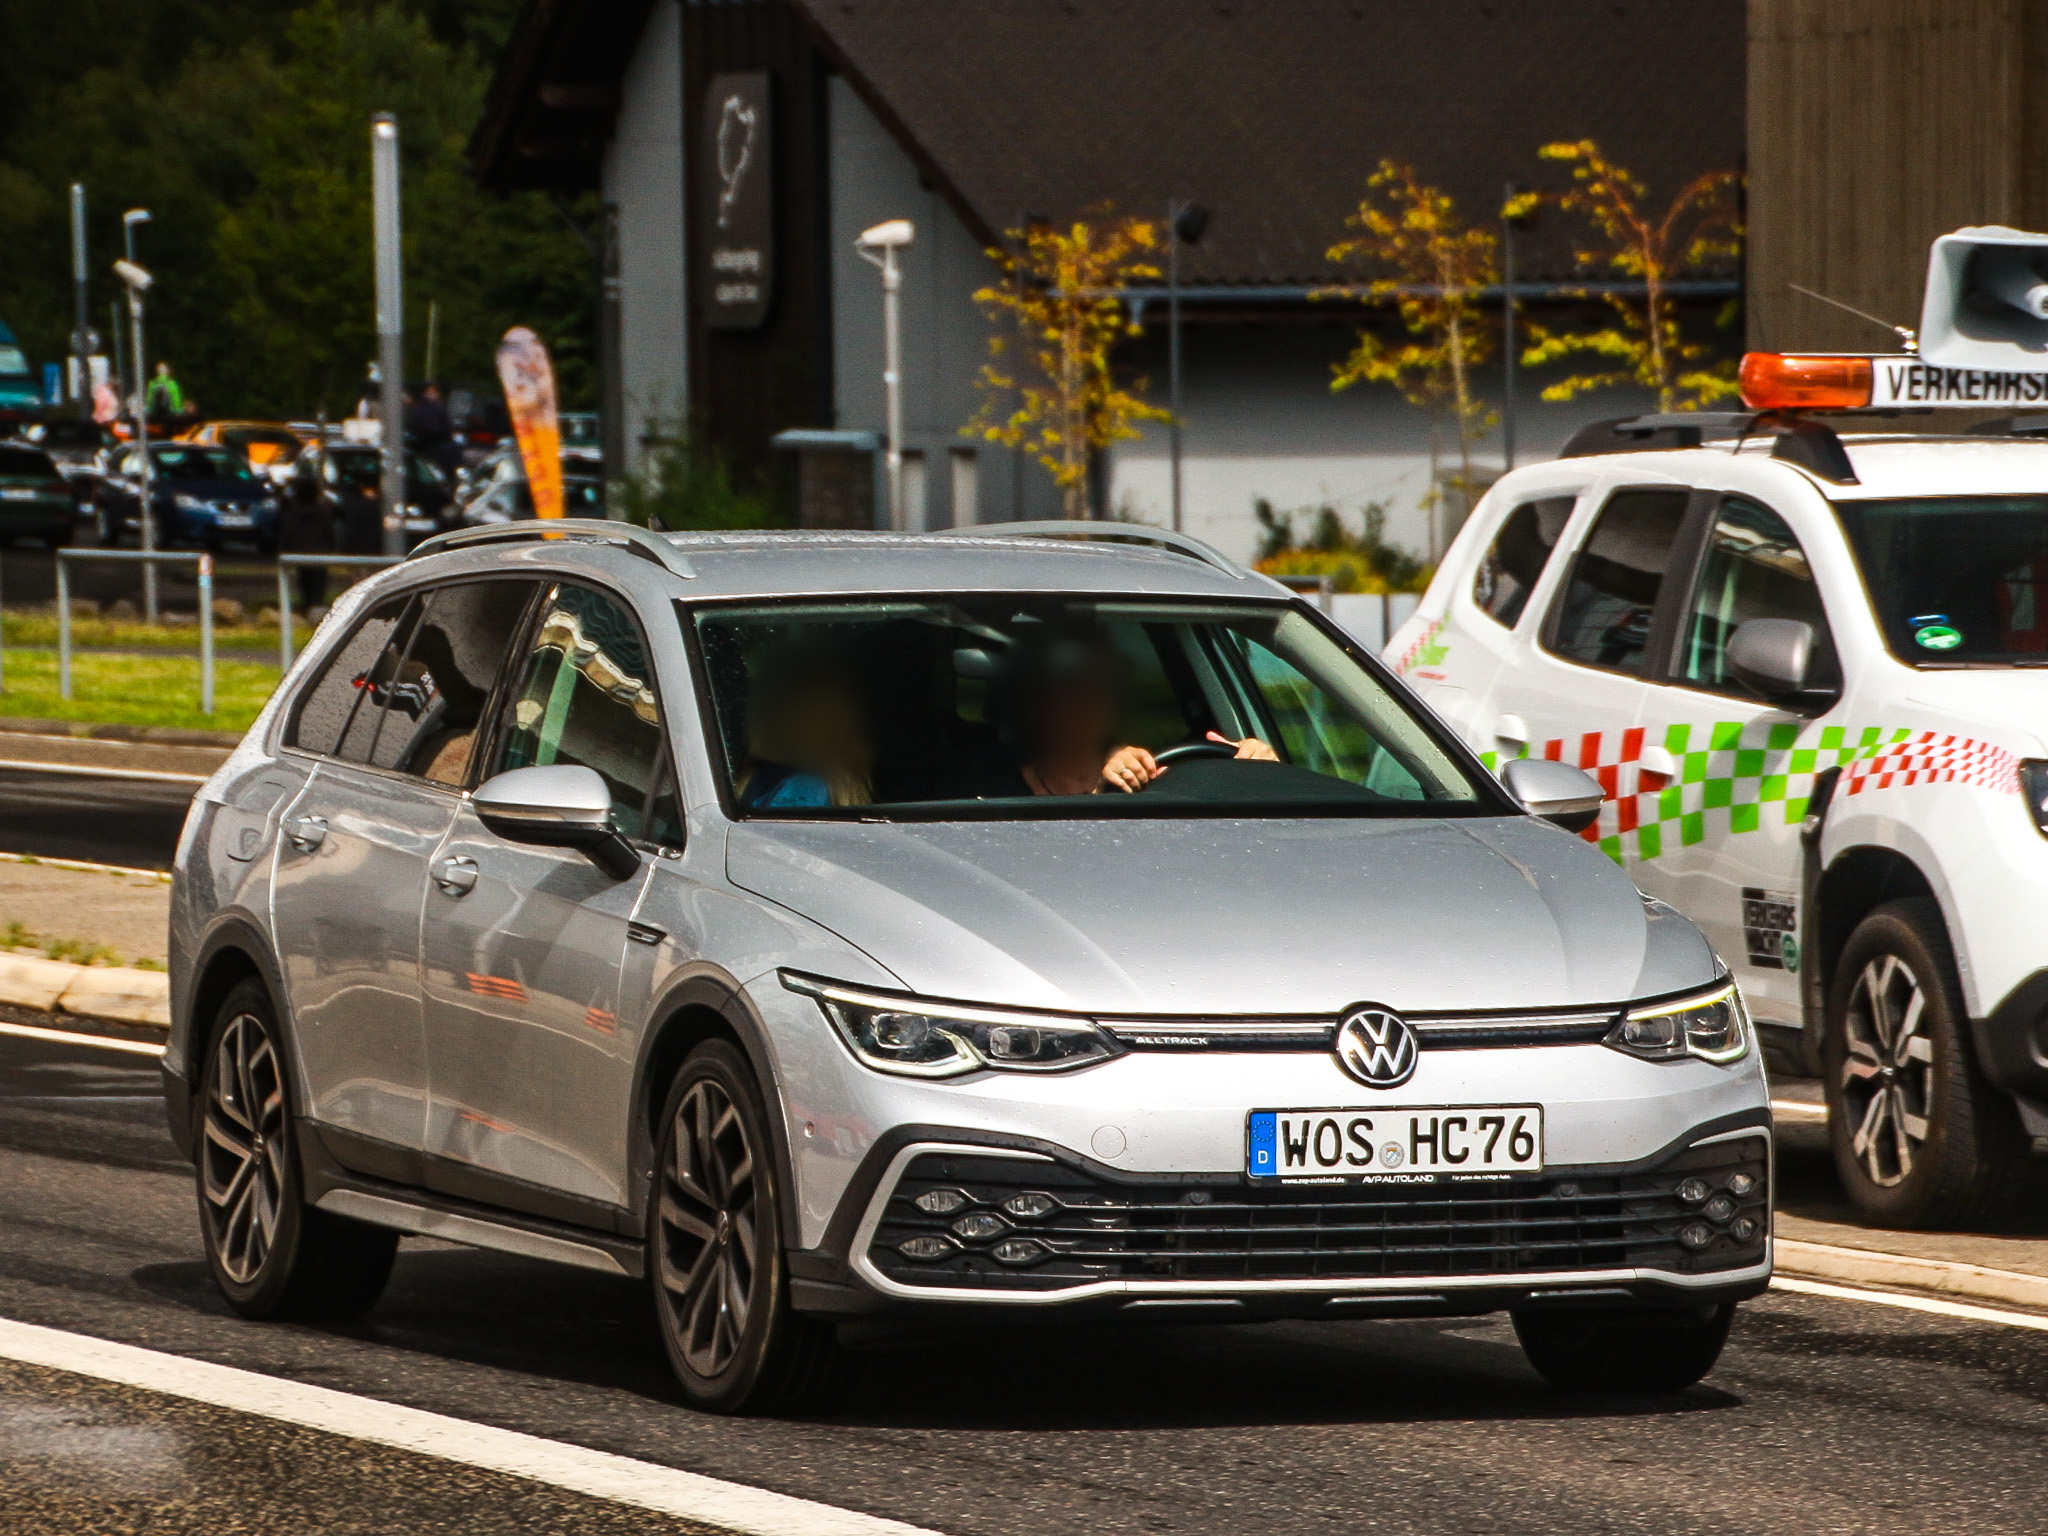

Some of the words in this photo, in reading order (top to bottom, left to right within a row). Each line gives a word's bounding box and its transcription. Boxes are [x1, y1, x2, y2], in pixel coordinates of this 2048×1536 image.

[1887, 365, 2048, 401] VERKEHRS
[1135, 1036, 1208, 1045] ALLTRACK
[1281, 1118, 1374, 1167] WOS
[1257, 1150, 1269, 1164] D
